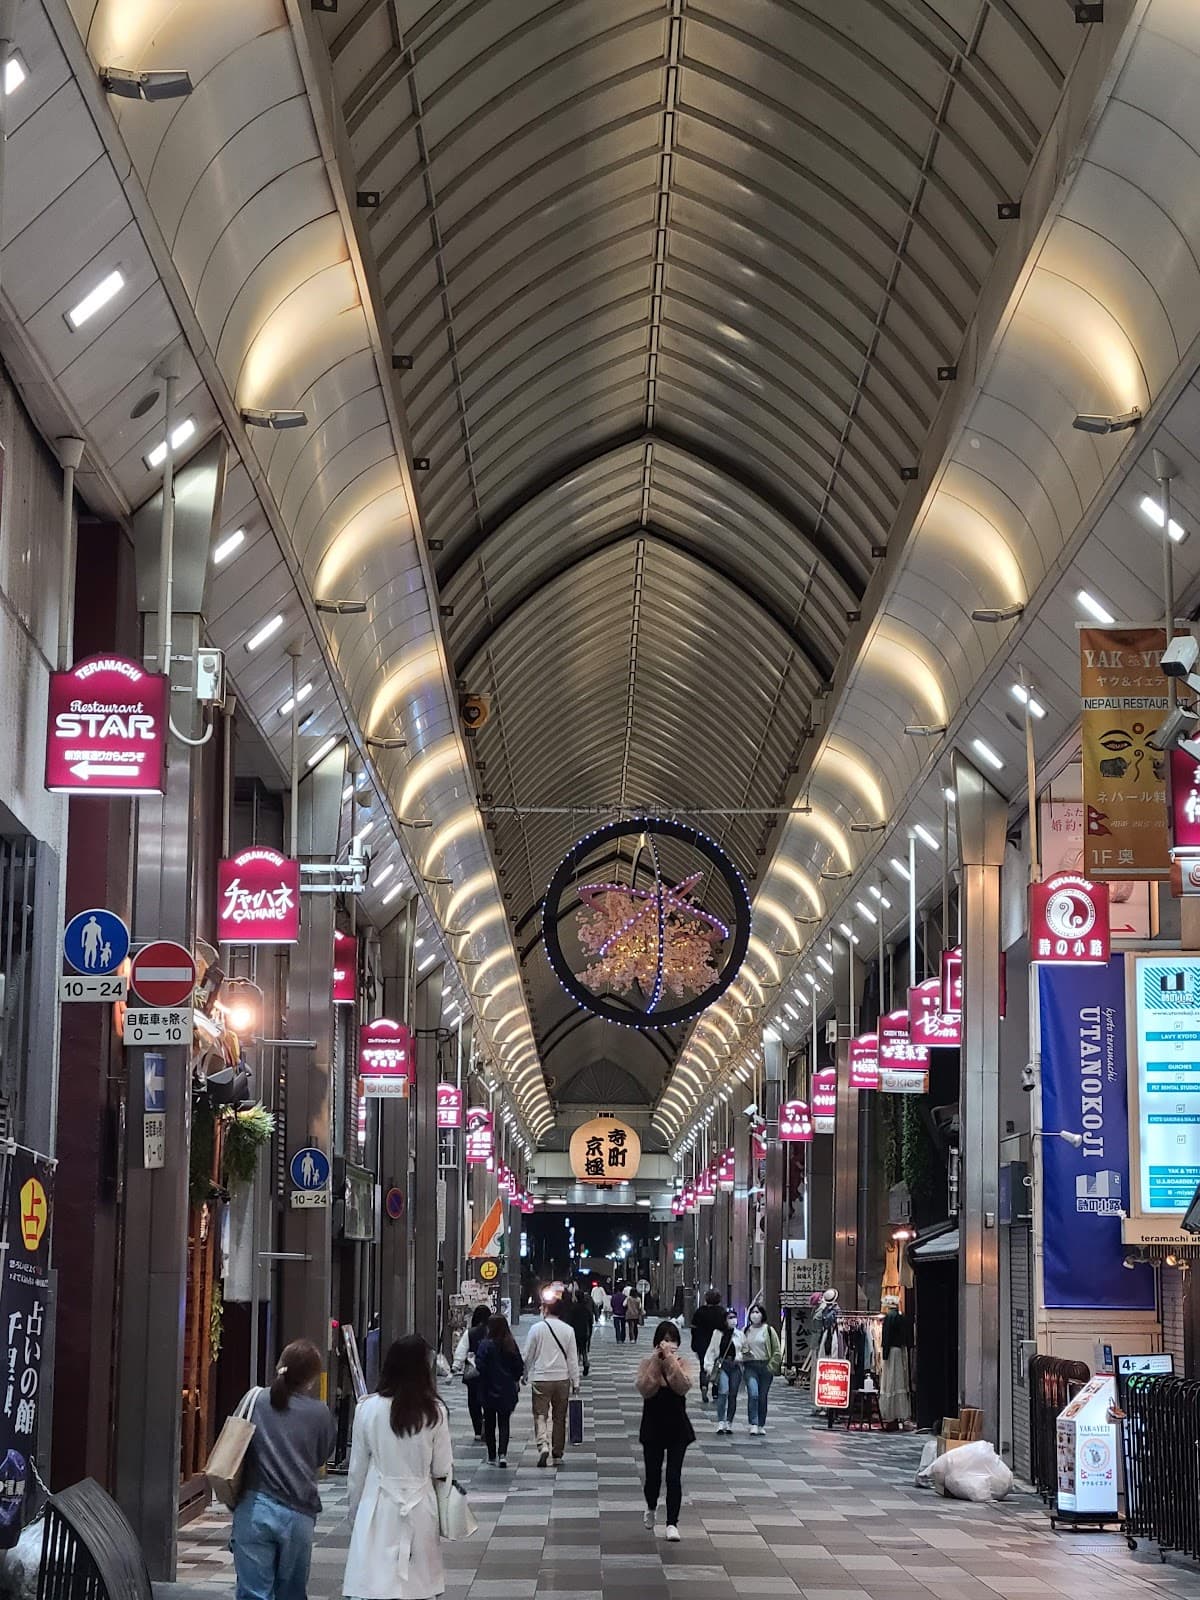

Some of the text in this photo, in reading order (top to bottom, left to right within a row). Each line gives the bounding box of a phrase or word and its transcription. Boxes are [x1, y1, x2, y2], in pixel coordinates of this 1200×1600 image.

[1083, 649, 1122, 668] YAK
[75, 660, 142, 681] TERAMACHI
[1097, 675, 1166, 687] ヤク&イエテ
[70, 700, 144, 713] Restaurant
[1084, 698, 1120, 709] NEPALI
[55, 713, 155, 739] STAR
[235, 851, 284, 867] TERAMACHI
[1092, 850, 1113, 865] 1F
[1048, 876, 1094, 891] TERAMACHI
[64, 982, 123, 997] 10-24
[127, 1012, 189, 1026] 自転車を除く
[1101, 1007, 1118, 1083] kyoto teramachi
[377, 1082, 401, 1094] KICS
[1079, 1006, 1104, 1158] UTANOKOJI
[607, 1128, 628, 1168] 寺町
[584, 1136, 606, 1177] 京極
[294, 1193, 327, 1205] 10-24
[23, 1182, 42, 1240] 占
[1141, 1235, 1188, 1243] teramachi
[794, 1310, 810, 1352] キムラ
[15, 1300, 44, 1434] 占いの館
[1122, 1359, 1137, 1371] 4F
[818, 1371, 849, 1382] Heaven
[1080, 1424, 1092, 1433] YAK
